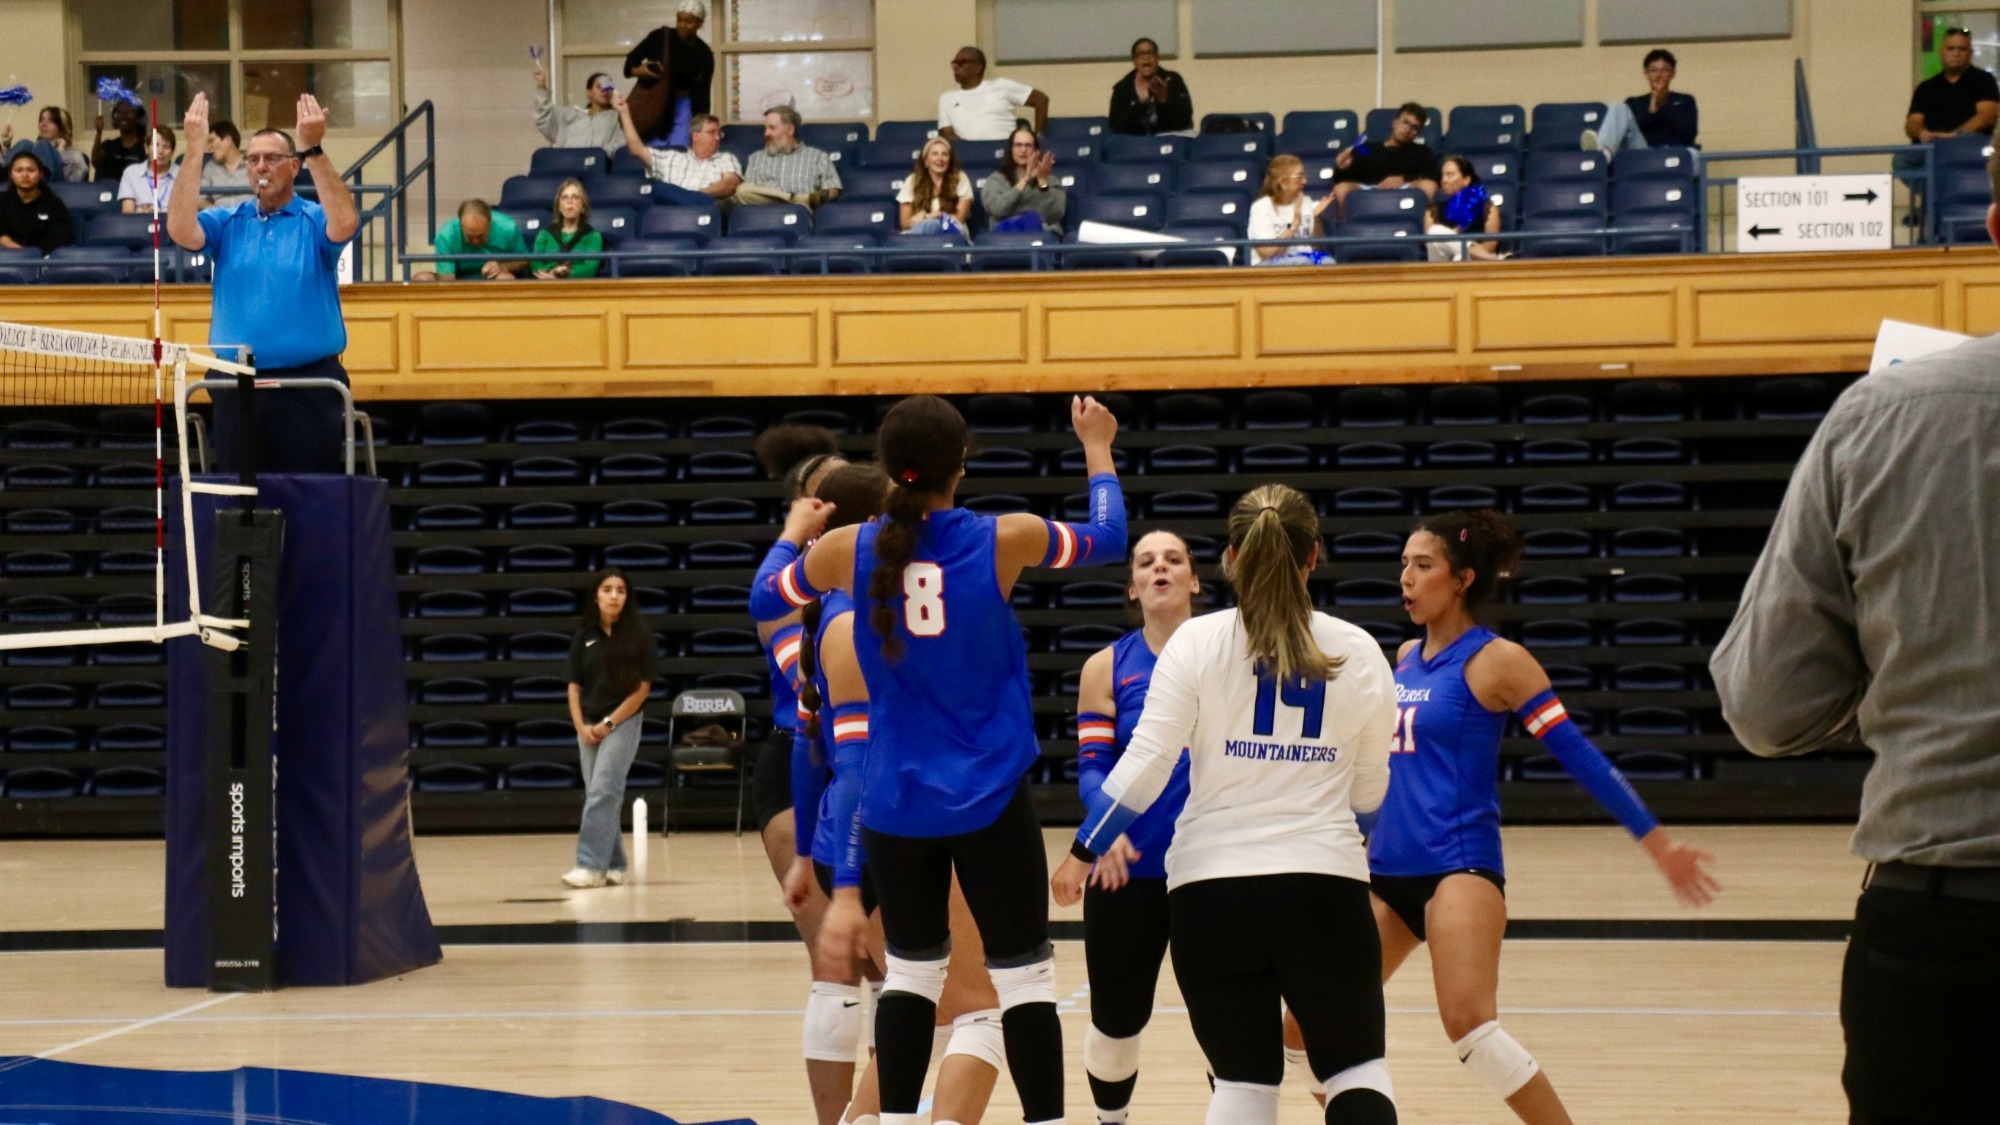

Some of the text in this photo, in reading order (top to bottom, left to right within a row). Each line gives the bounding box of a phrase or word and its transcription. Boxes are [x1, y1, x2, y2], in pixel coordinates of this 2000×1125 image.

[1745, 190, 1829, 208] SECTION 101
[1798, 221, 1883, 239] SECTION 102
[903, 561, 947, 638] 8
[682, 695, 736, 713] BEREA
[1224, 740, 1338, 763] MOUNTAINEERS
[229, 782, 246, 898] sports imports
